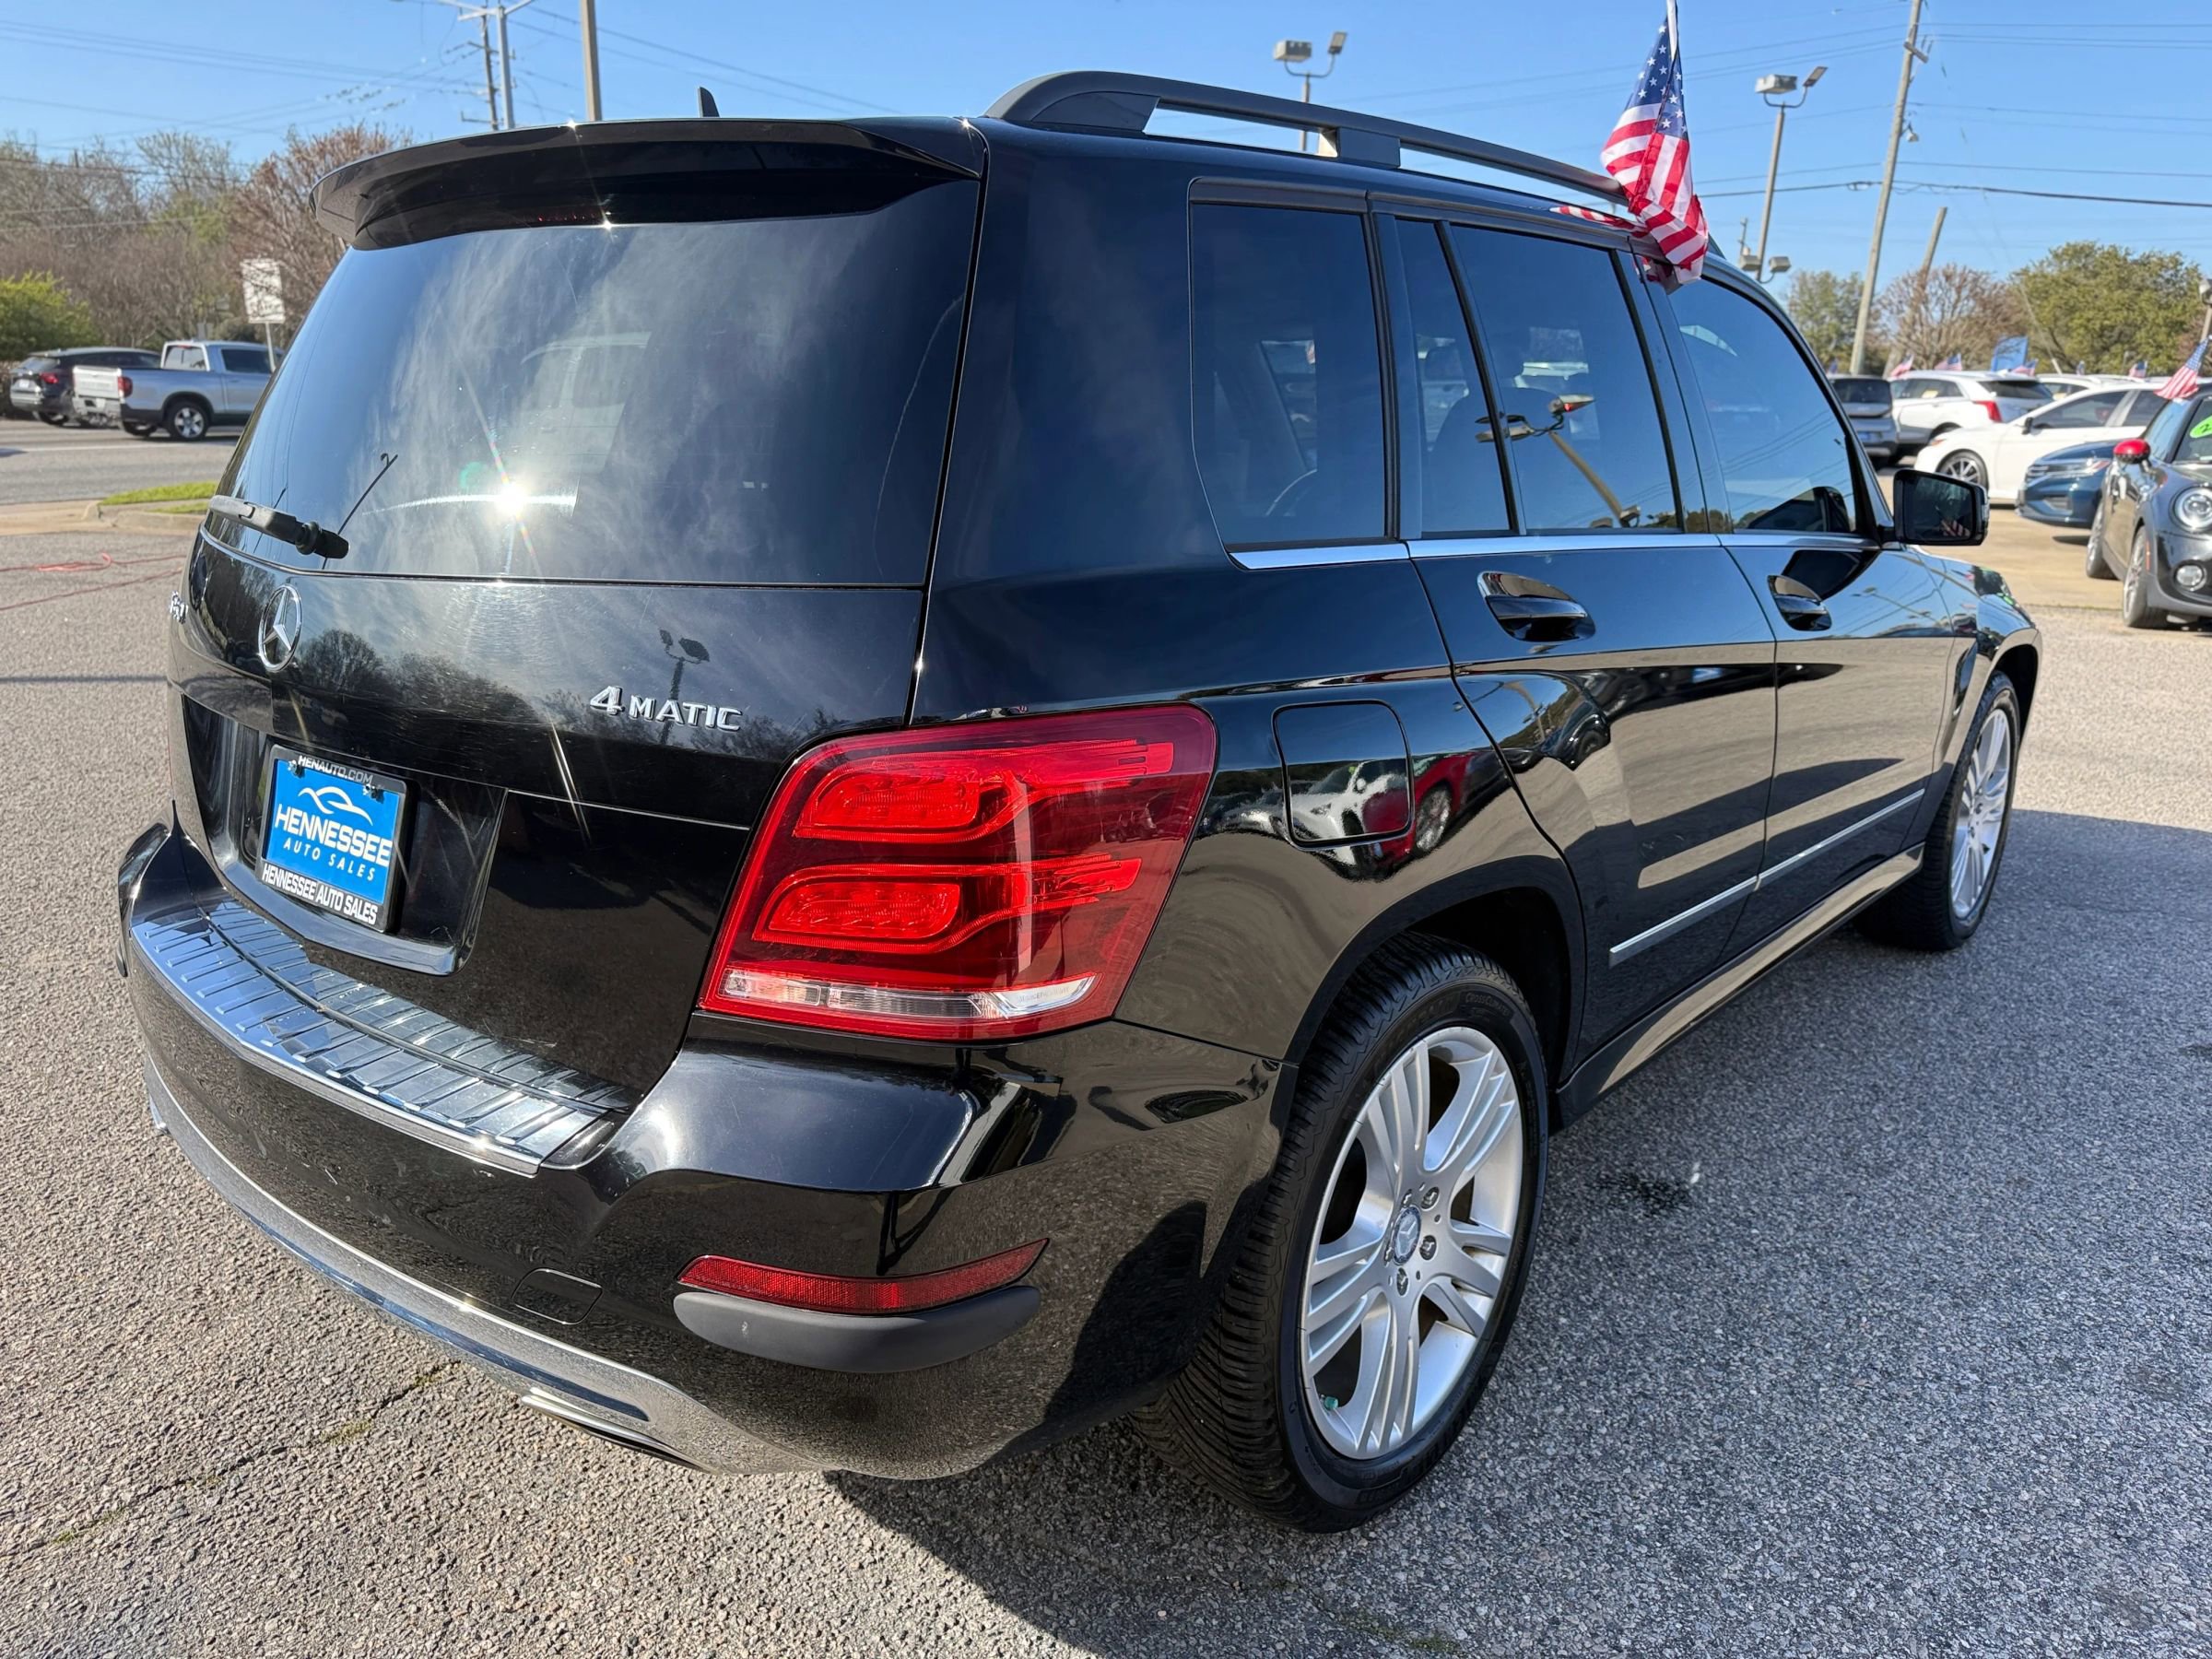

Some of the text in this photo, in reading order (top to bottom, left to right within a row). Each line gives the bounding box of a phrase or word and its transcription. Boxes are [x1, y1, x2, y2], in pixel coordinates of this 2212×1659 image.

[590, 686, 743, 731] 4MATIC
[298, 755, 373, 784] HENAUTO.COM
[275, 804, 393, 867] HENNESSEE
[283, 837, 376, 881] AUTO SALES
[261, 863, 378, 925] HENNESSEE AUTO SALES
